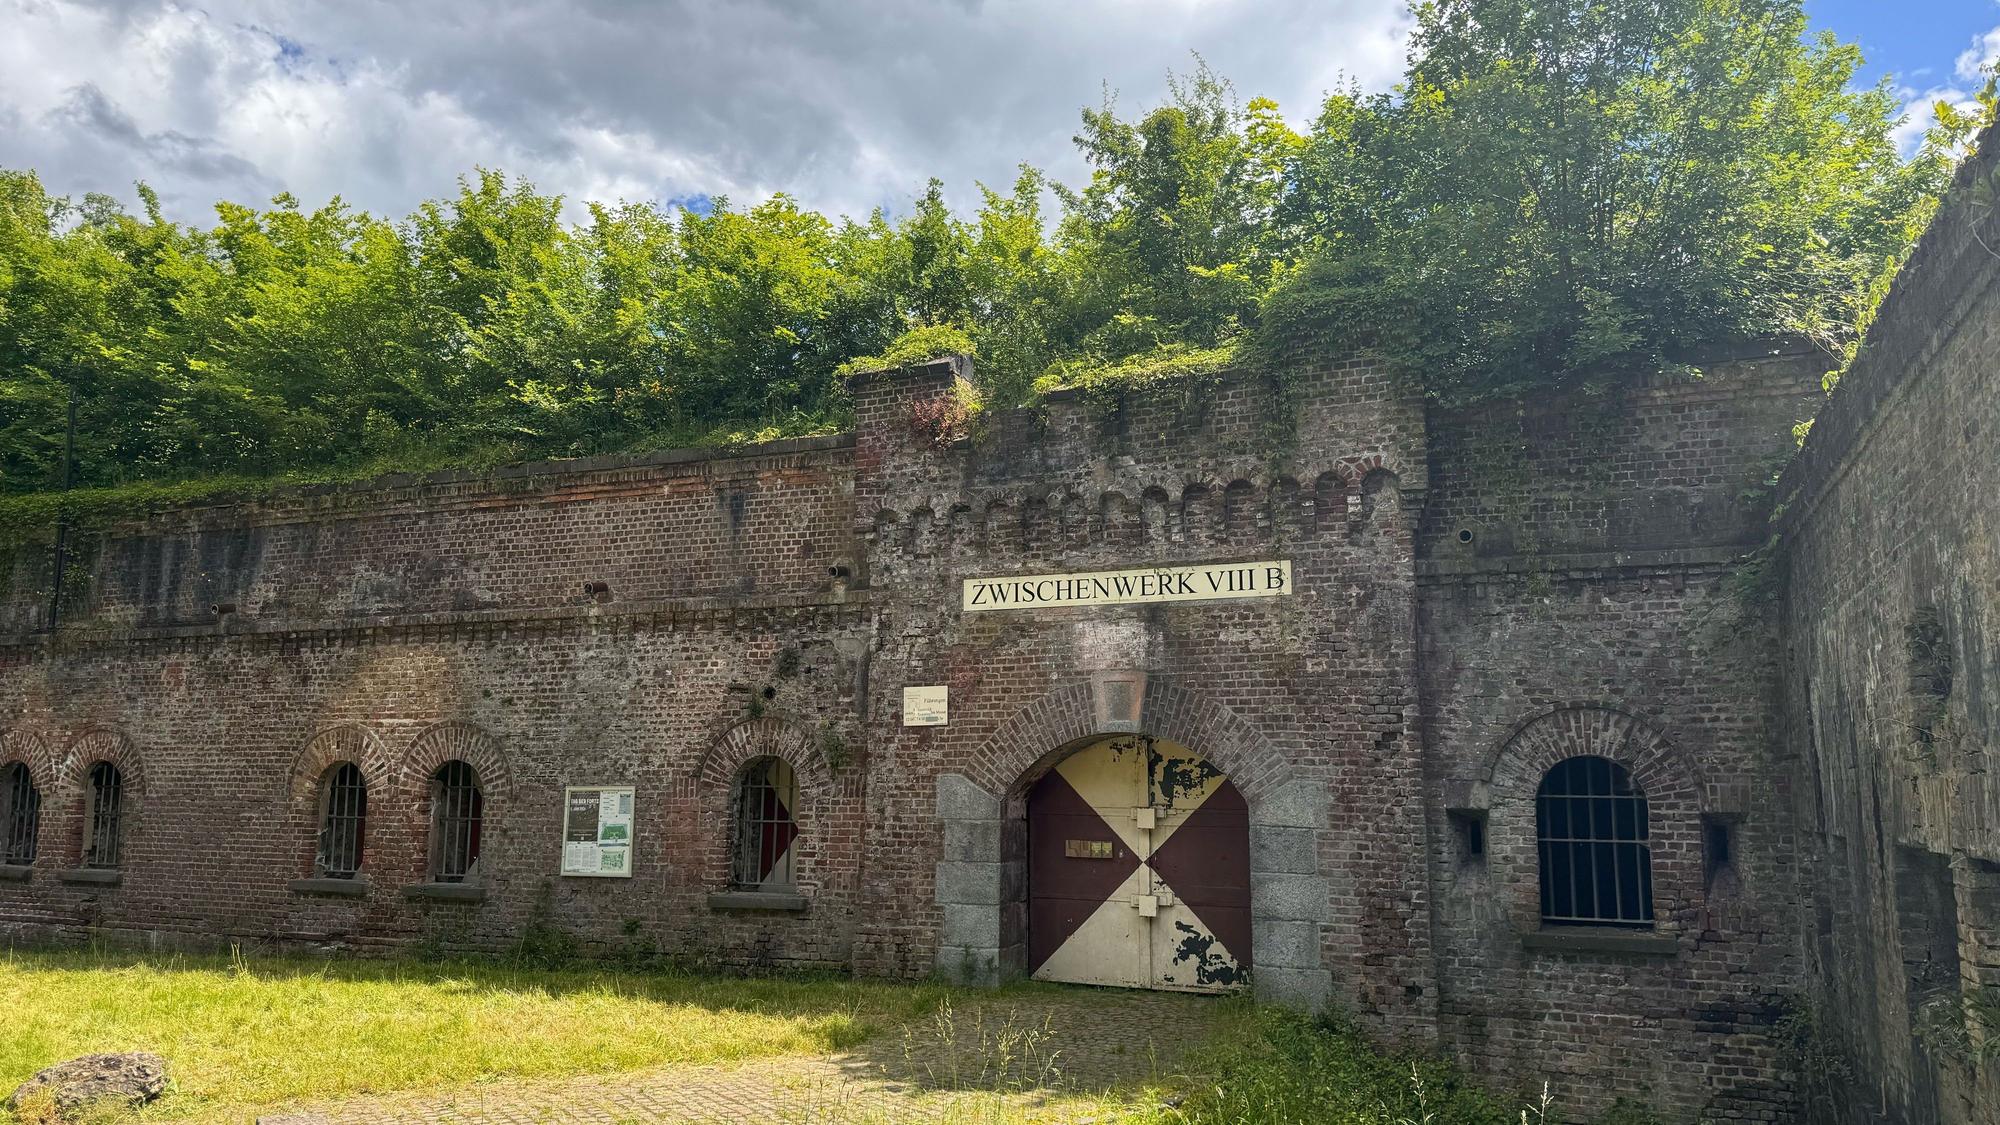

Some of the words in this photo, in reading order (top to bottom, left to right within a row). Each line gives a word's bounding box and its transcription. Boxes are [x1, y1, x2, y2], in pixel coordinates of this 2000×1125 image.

[971, 572, 1196, 605] ZWISCHENWERK
[1205, 568, 1256, 593] VIII
[1265, 566, 1285, 590] B
